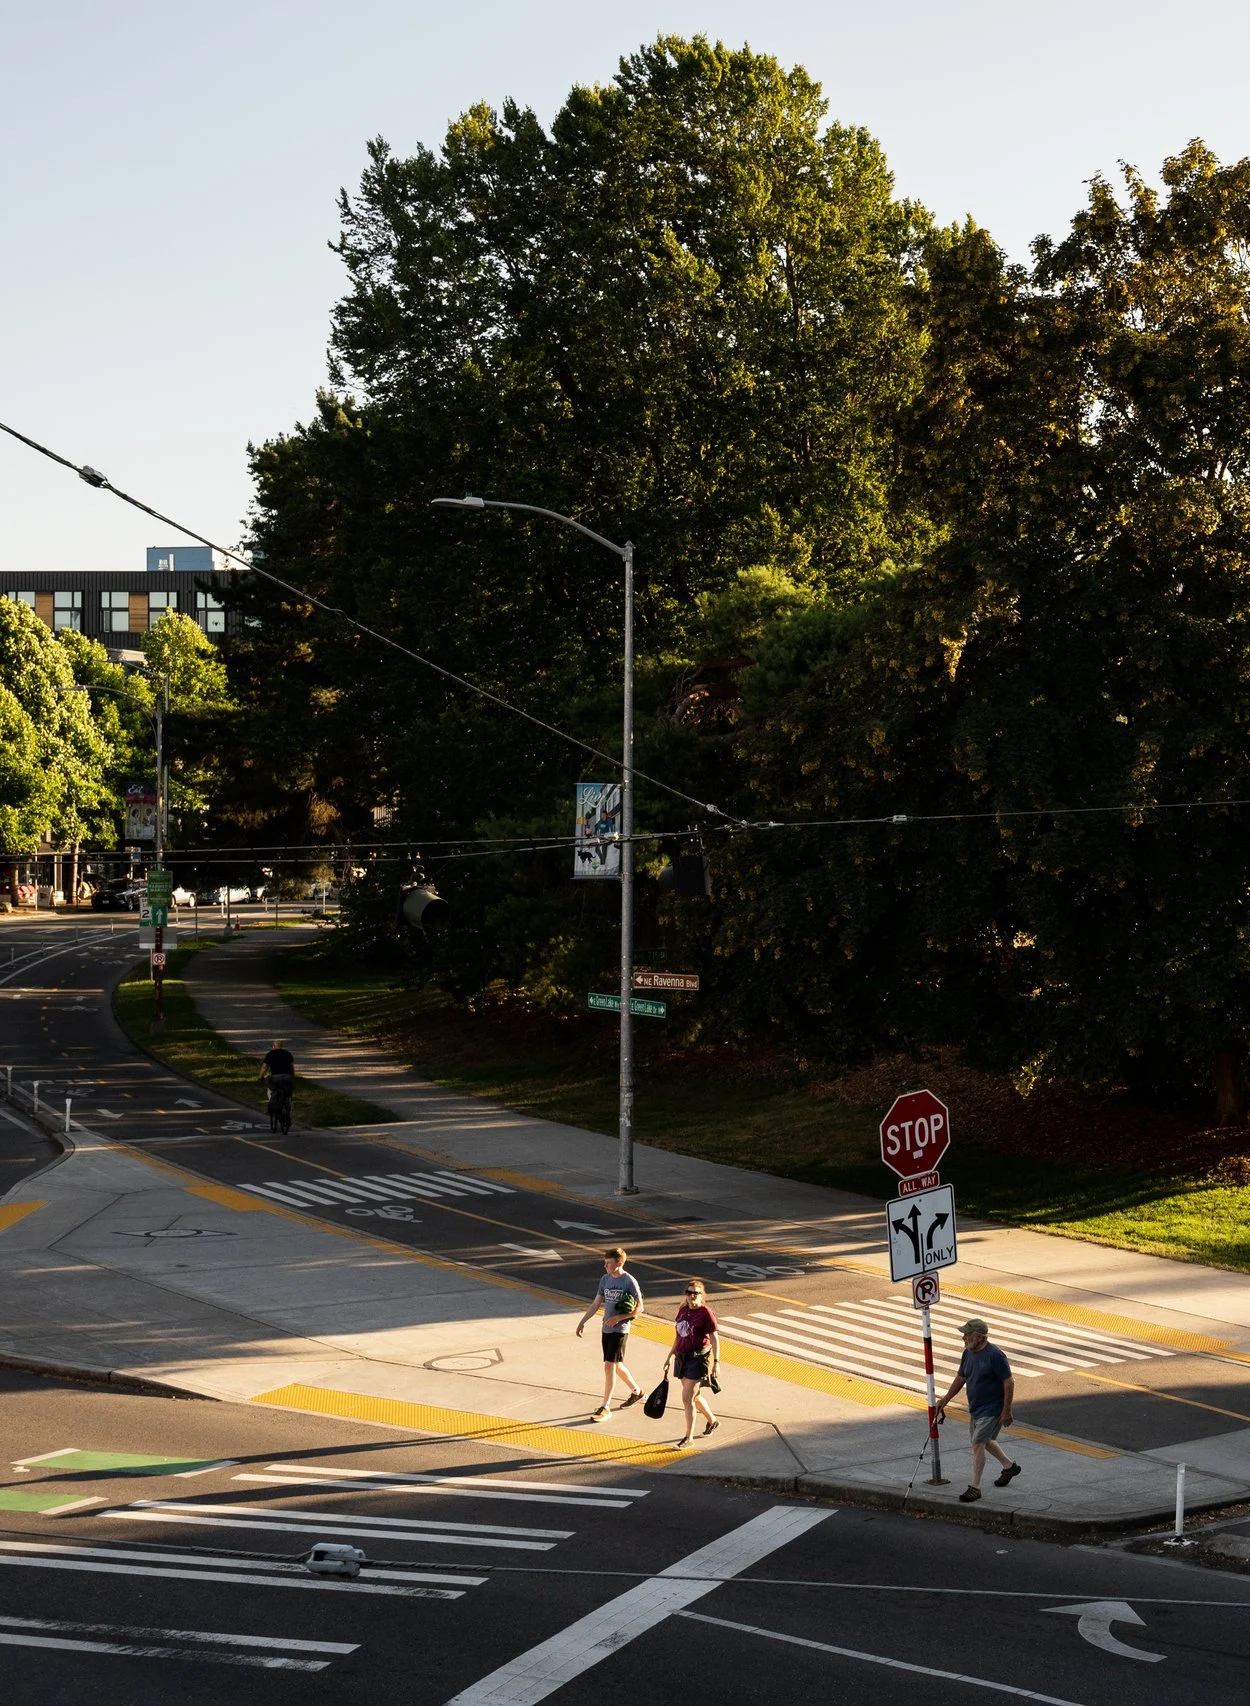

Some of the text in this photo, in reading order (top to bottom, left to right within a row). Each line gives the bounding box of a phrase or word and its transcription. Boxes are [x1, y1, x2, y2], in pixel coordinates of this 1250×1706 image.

[142, 910, 149, 918] 2
[643, 975, 697, 988] NE Ravenna Blvd
[596, 995, 605, 1008] Green
[634, 1000, 645, 1013] Green
[645, 1002, 653, 1014] Lake
[886, 1113, 944, 1156] STOP
[902, 1173, 937, 1194] ALL WAY
[925, 1245, 954, 1266] ONLY
